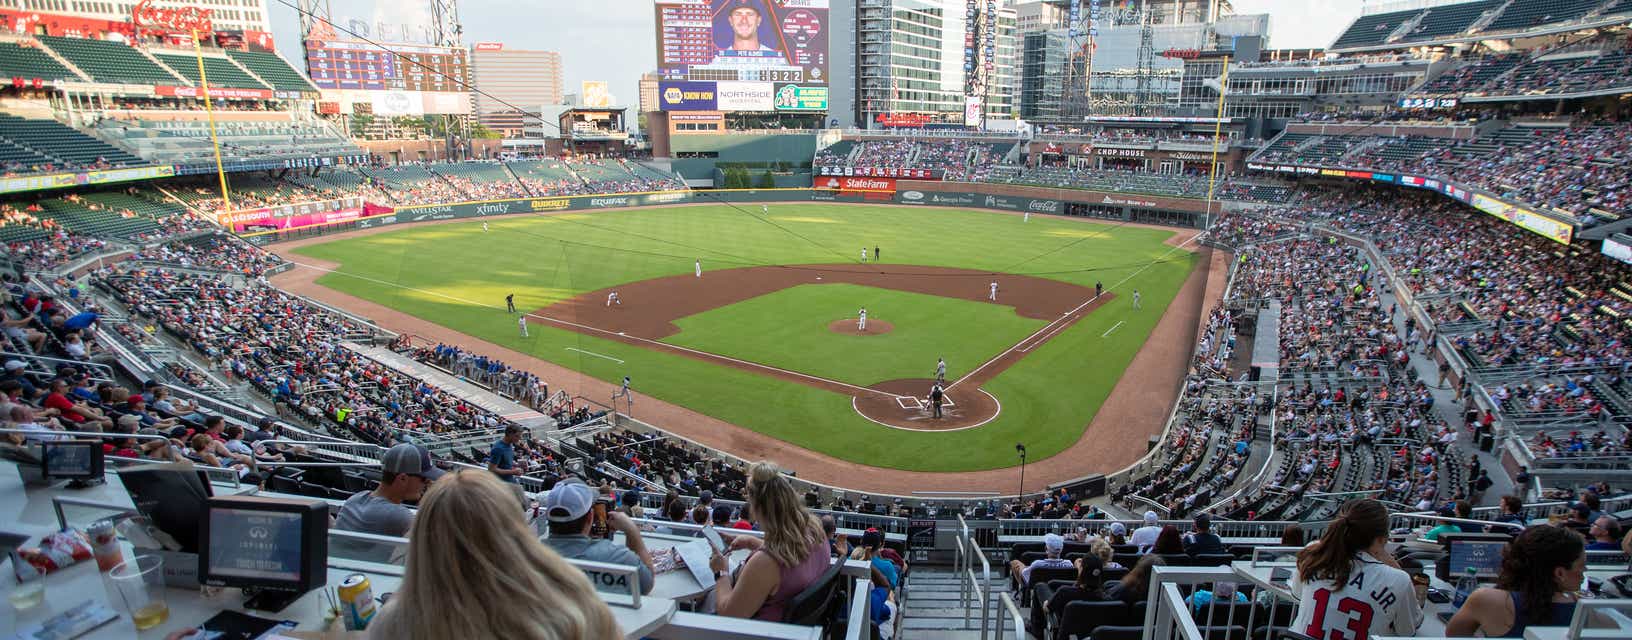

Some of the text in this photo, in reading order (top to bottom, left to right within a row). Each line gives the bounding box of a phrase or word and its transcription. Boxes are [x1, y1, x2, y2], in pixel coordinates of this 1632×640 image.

[772, 71, 800, 80] 3 2 2
[684, 91, 713, 100] KNOW HOW
[531, 199, 570, 208] QUIKRETE
[591, 198, 626, 207] EQUIFAX
[1029, 200, 1057, 212] Coca-Cola
[411, 206, 454, 215] WELLSTAR
[476, 203, 509, 216] xfinity
[1305, 587, 1375, 640] 13
